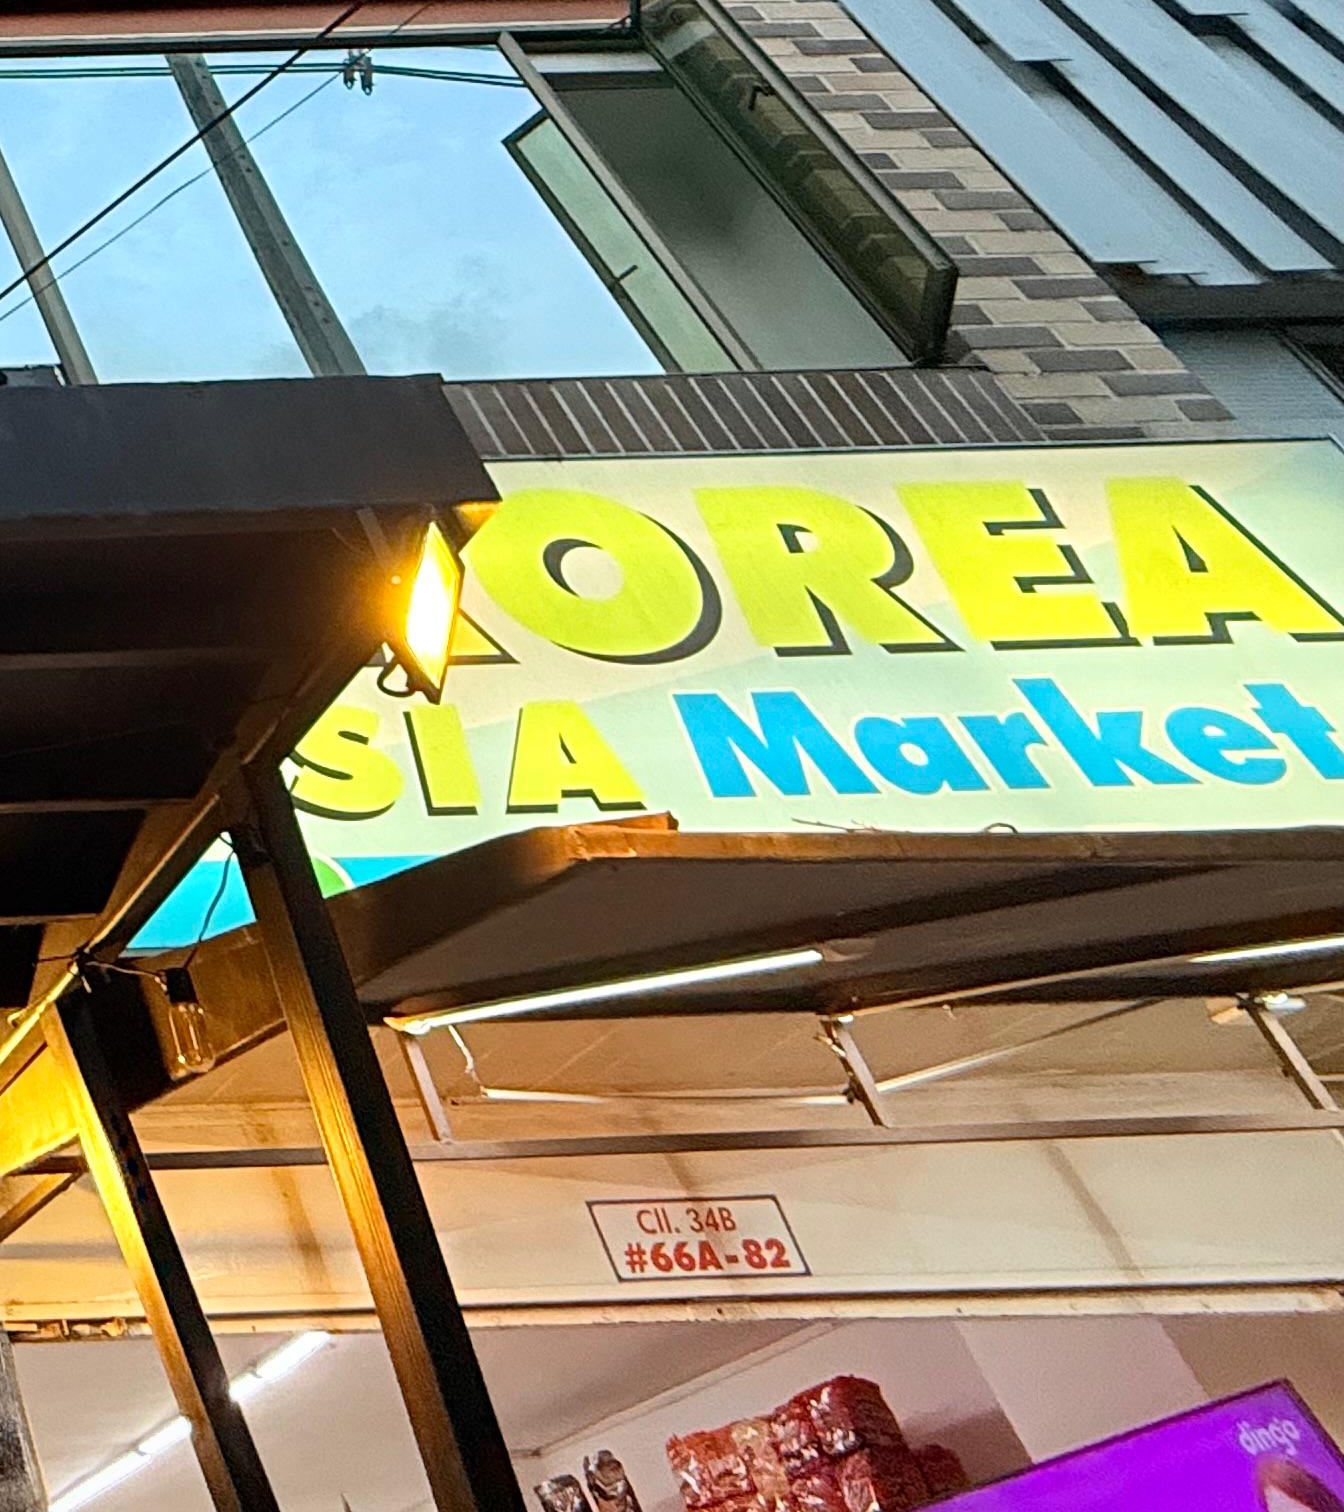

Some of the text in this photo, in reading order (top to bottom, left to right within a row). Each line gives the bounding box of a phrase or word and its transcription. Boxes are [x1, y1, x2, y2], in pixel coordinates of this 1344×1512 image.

[290, 677, 1344, 820] SIA Market
[685, 1206, 737, 1234] 34B
[624, 1237, 792, 1274] #66A-82
